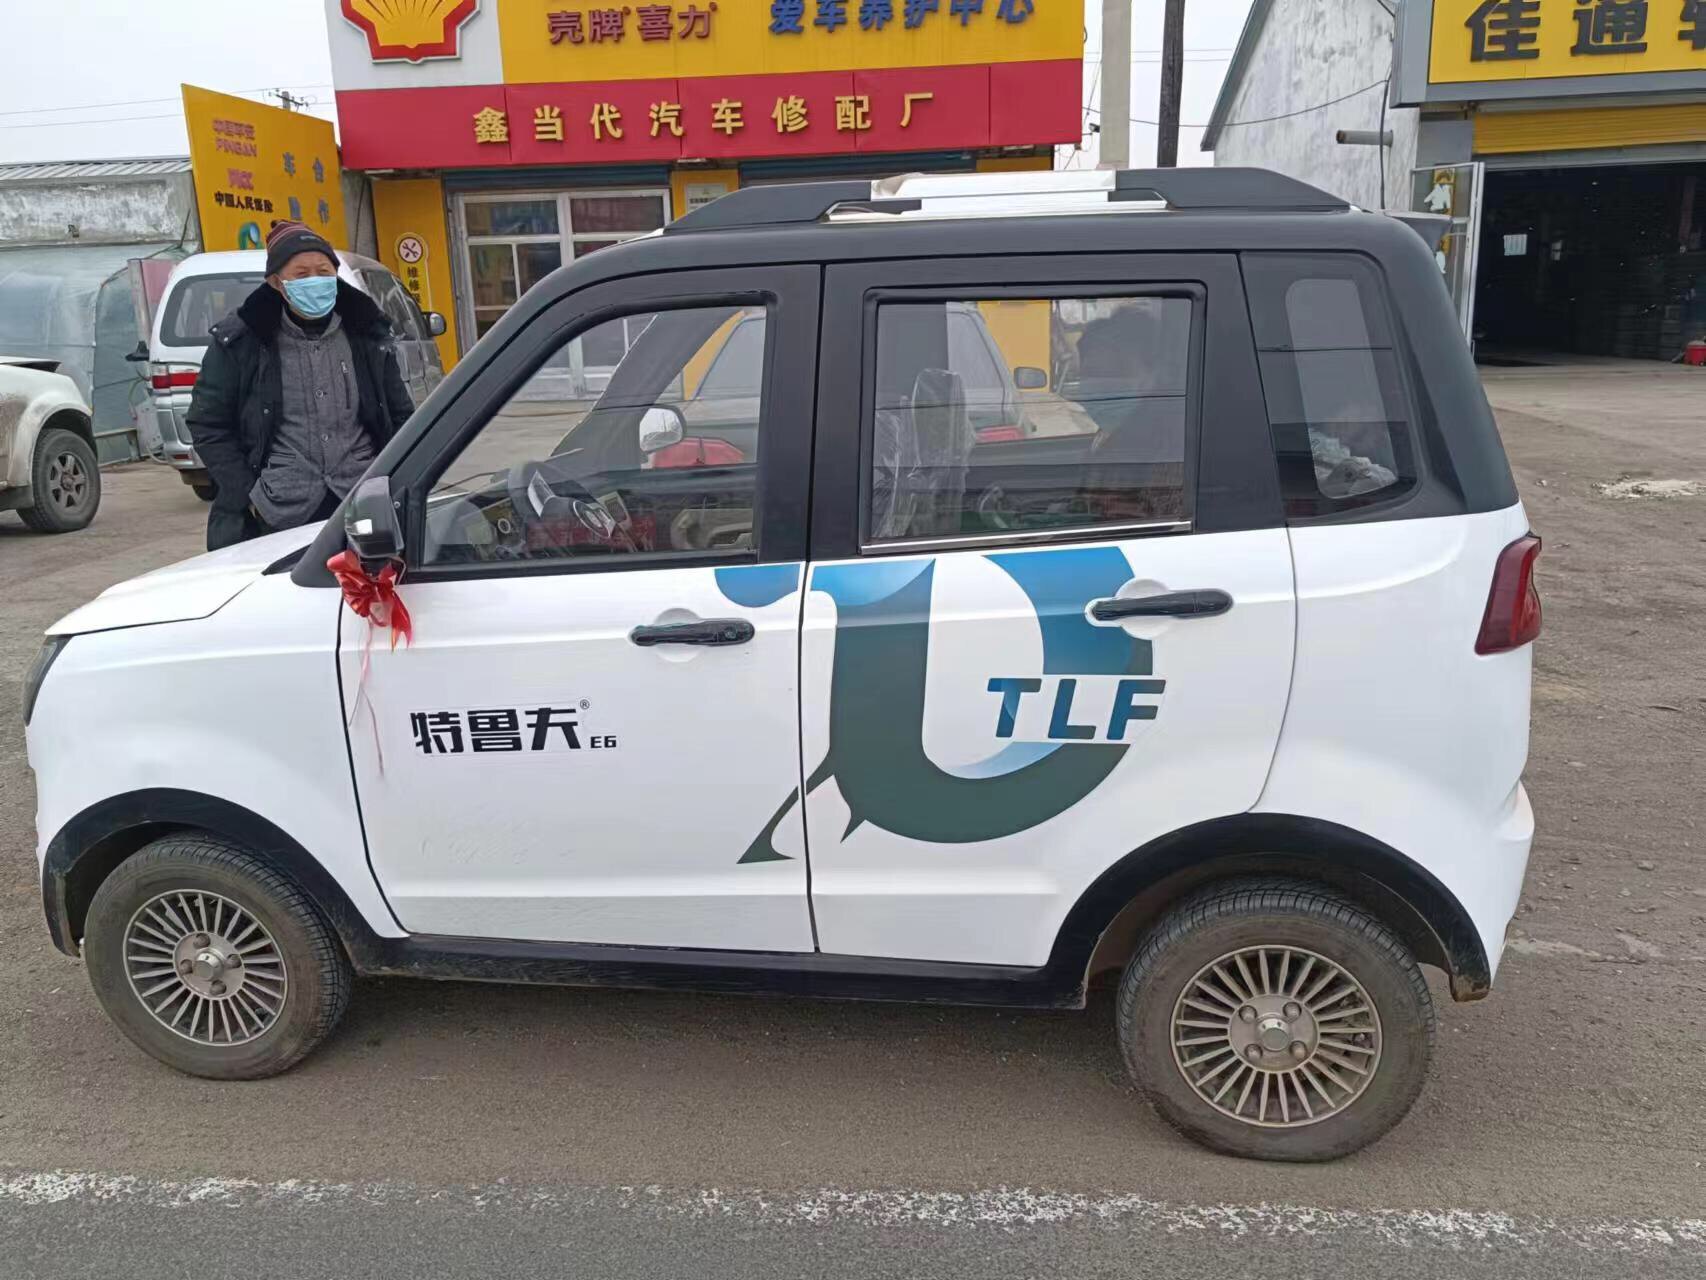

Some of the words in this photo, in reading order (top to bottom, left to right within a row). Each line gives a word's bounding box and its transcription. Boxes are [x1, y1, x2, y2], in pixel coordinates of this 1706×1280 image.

[473, 91, 933, 144] 鑫当代汽车修配厂
[410, 707, 581, 754] 特鲁夫
[987, 677, 1167, 740] TLF
[590, 735, 617, 749] E6
